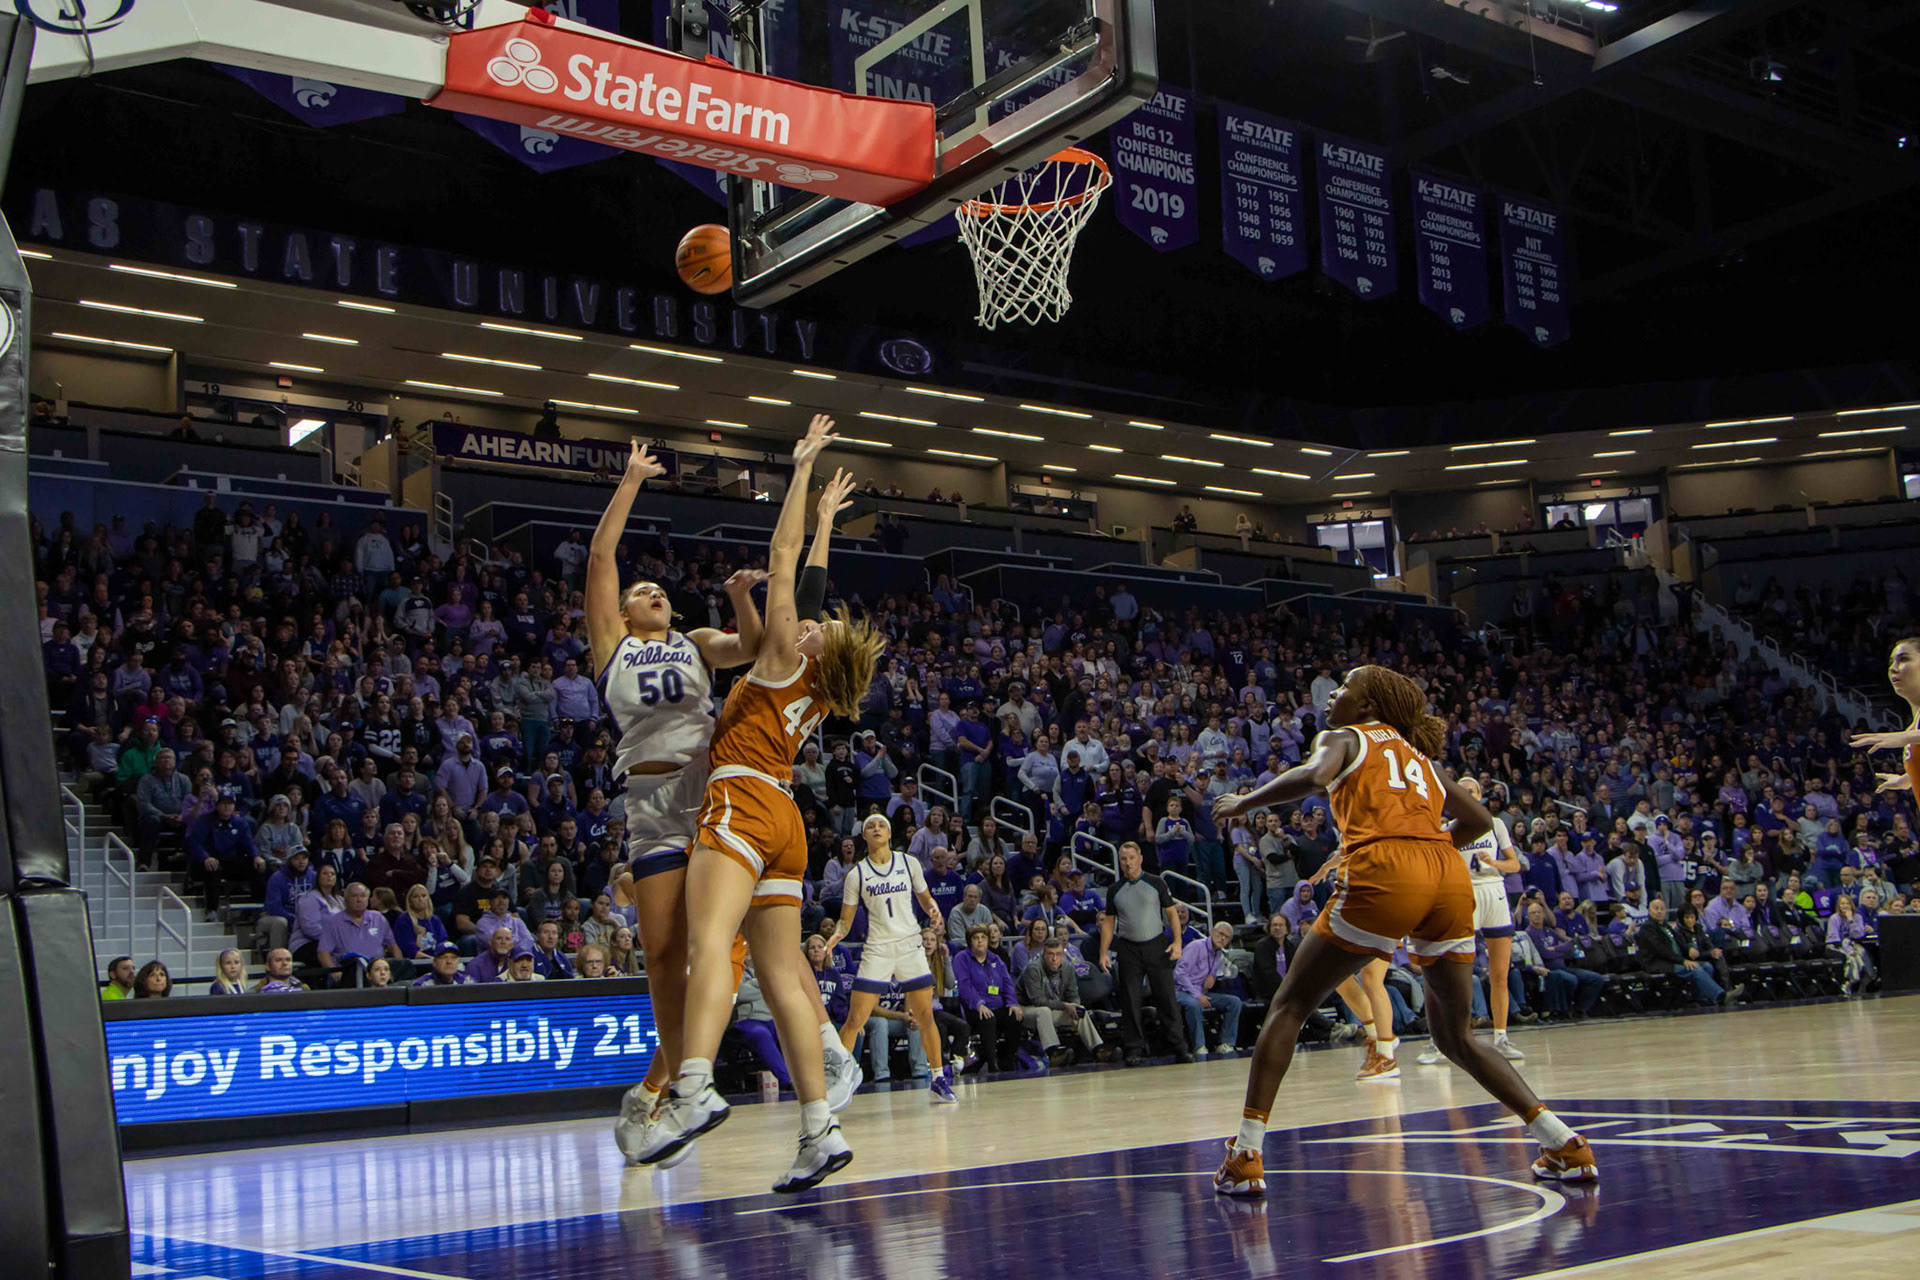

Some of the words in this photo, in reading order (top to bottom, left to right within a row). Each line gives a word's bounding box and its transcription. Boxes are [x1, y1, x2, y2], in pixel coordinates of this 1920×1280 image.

[1132, 121, 1156, 140] BIG
[1158, 129, 1174, 146] 12
[1226, 116, 1293, 147] K-STATE
[1117, 135, 1193, 166] CONFERENCE
[1322, 142, 1384, 172] K-STATE
[1117, 150, 1195, 185] CHAMPIONS
[1234, 151, 1289, 173] CONFERENCE
[1227, 160, 1298, 186] CHAMPIONSHIPS
[1236, 182, 1258, 197] 1917
[1268, 190, 1289, 205] 1951
[1325, 184, 1389, 209] CHAMPIONSHIPS
[1331, 176, 1381, 197] CONFERENCE
[1418, 180, 1476, 208] K-STATE
[1130, 184, 1185, 219] 2019
[1237, 196, 1259, 211] 1919
[1269, 204, 1291, 218] 1956
[1238, 211, 1260, 226] 1948
[1270, 218, 1292, 232] 1958
[1333, 205, 1355, 220] 1960
[1426, 211, 1474, 232] CONFERENCE
[1503, 202, 1556, 229] K-STATE
[1239, 225, 1260, 240] 1950
[1270, 232, 1294, 246] 1959
[1335, 219, 1355, 233] 1961
[1364, 226, 1385, 240] 1970
[1420, 219, 1481, 243] CHAMPIONSHIPS
[1336, 233, 1357, 247] 1963
[1365, 240, 1386, 254] 1972
[1429, 239, 1449, 253] 1977
[1525, 236, 1542, 251] NIT
[1337, 247, 1358, 261] 1964
[1366, 254, 1388, 267] 1973
[1514, 259, 1533, 272] 1976
[1431, 266, 1451, 280] 2013
[184, 214, 398, 296] STATE
[453, 259, 818, 360] UNIVERSITY
[1432, 279, 1452, 293] 2019
[202, 383, 220, 396] 19
[347, 401, 363, 412] 20
[763, 453, 775, 463] 21
[1323, 513, 1336, 521] 22
[1360, 510, 1373, 519] 22
[624, 645, 692, 669] Wildcats
[636, 668, 684, 706] 50
[379, 729, 402, 753] 22
[1383, 748, 1428, 800] 14
[1470, 853, 1480, 872] 4
[866, 881, 907, 897] Wildcats
[885, 897, 893, 918] 1
[112, 1039, 240, 1100] njoy
[259, 1017, 578, 1084] Responsibly
